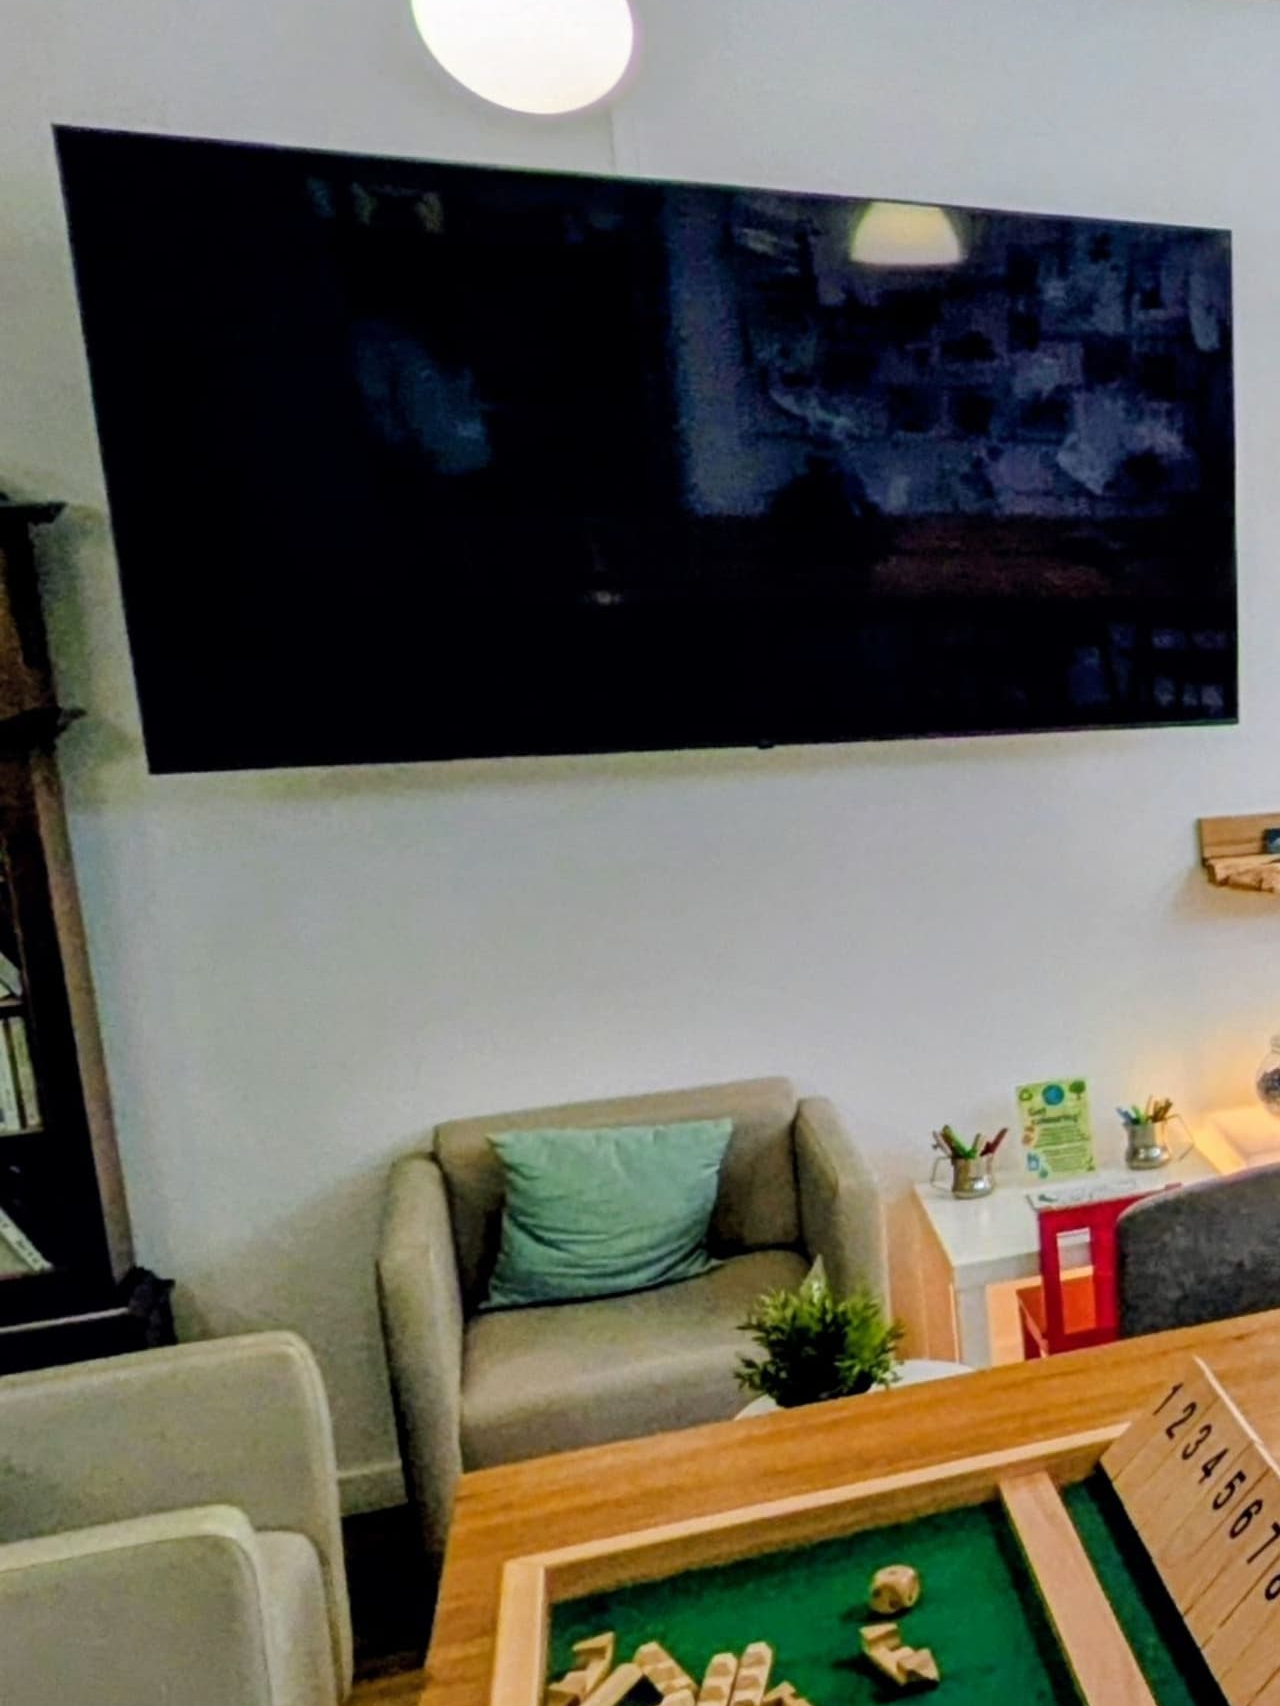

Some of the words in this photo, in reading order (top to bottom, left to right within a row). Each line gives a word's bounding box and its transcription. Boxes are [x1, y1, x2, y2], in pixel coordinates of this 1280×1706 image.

[1152, 1381, 1184, 1416] 1
[1164, 1401, 1198, 1440] 2
[1181, 1423, 1213, 1461] 3
[1197, 1447, 1230, 1485] 4
[1211, 1470, 1247, 1511] 5
[1228, 1498, 1264, 1540] 6
